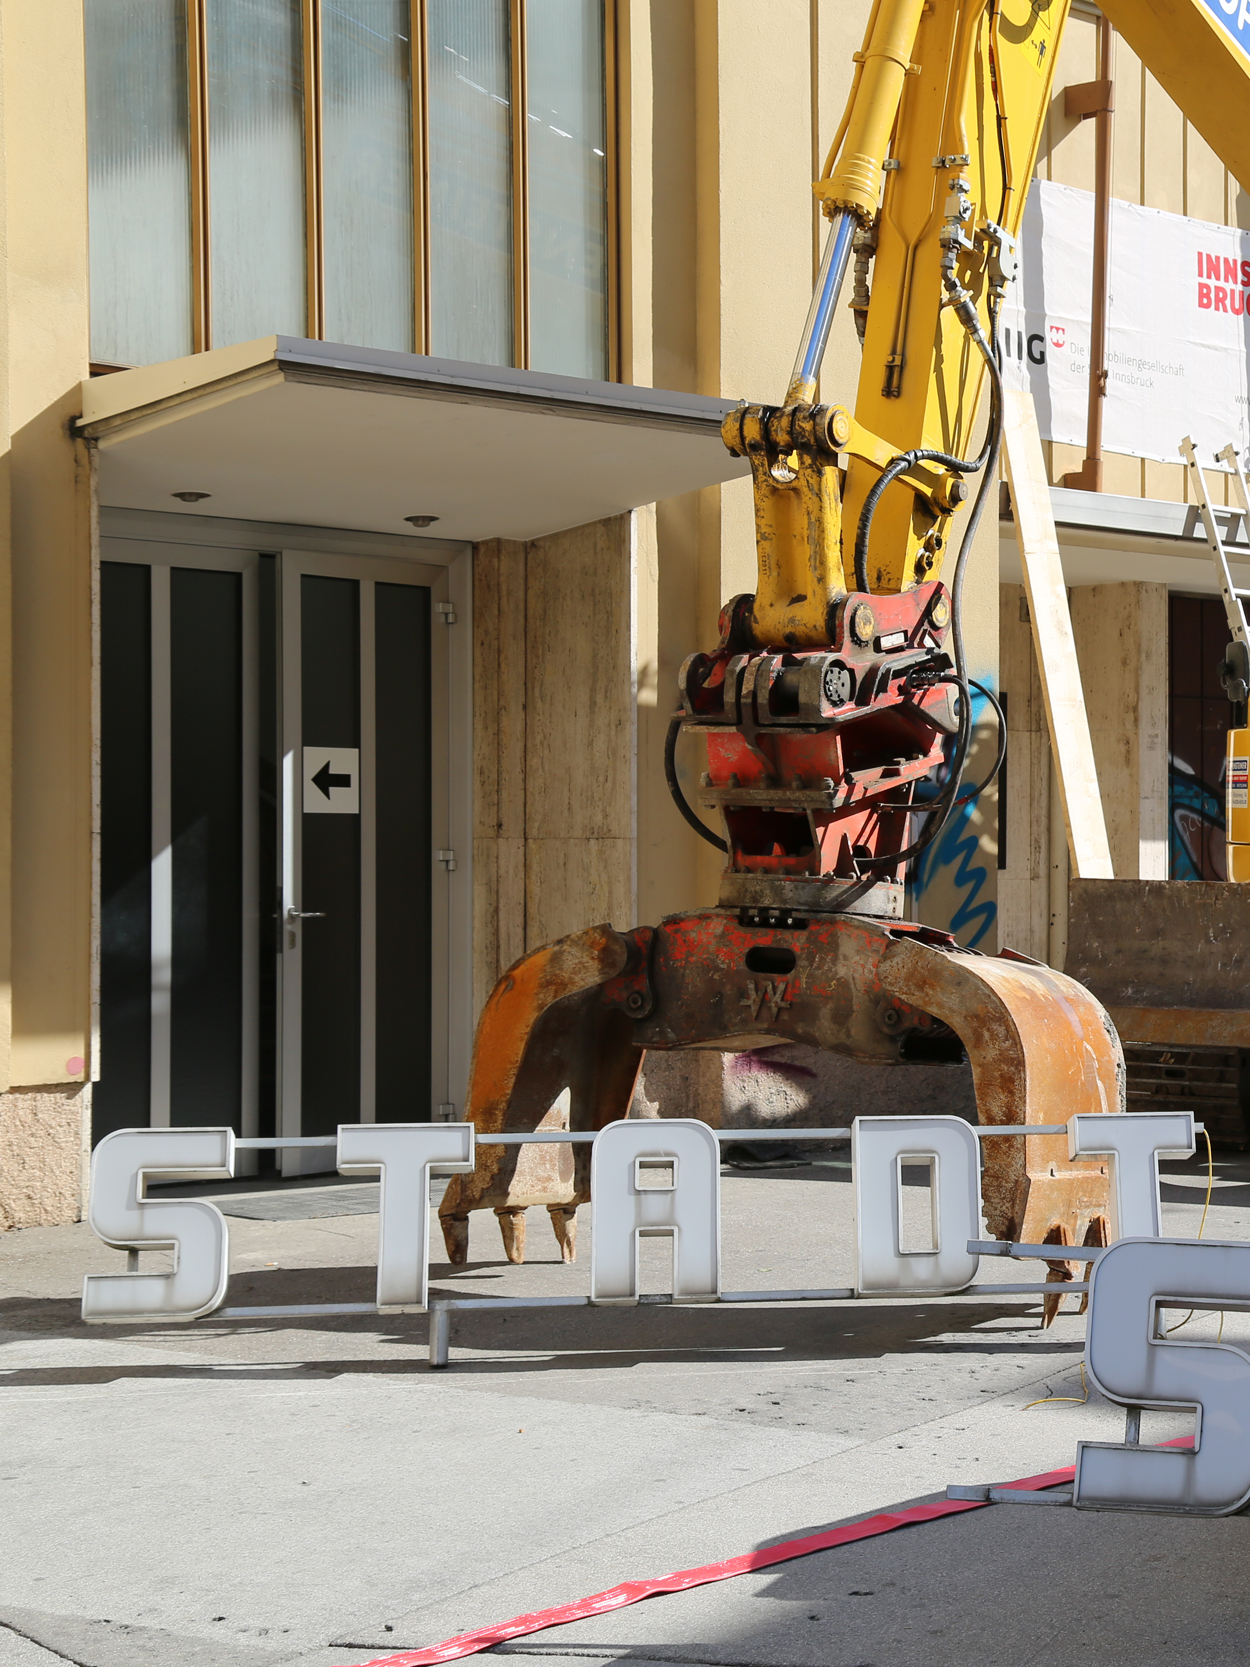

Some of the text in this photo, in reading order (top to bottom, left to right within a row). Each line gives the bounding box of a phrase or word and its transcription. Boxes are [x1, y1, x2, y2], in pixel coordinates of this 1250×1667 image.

[1004, 326, 1045, 365] IIG
[1070, 342, 1085, 356] Die
[1088, 345, 1186, 378] Iobiliengesellschaft
[1070, 360, 1085, 374] der
[1112, 369, 1155, 389] Innsbruck
[81, 1112, 1197, 1323] STADT
